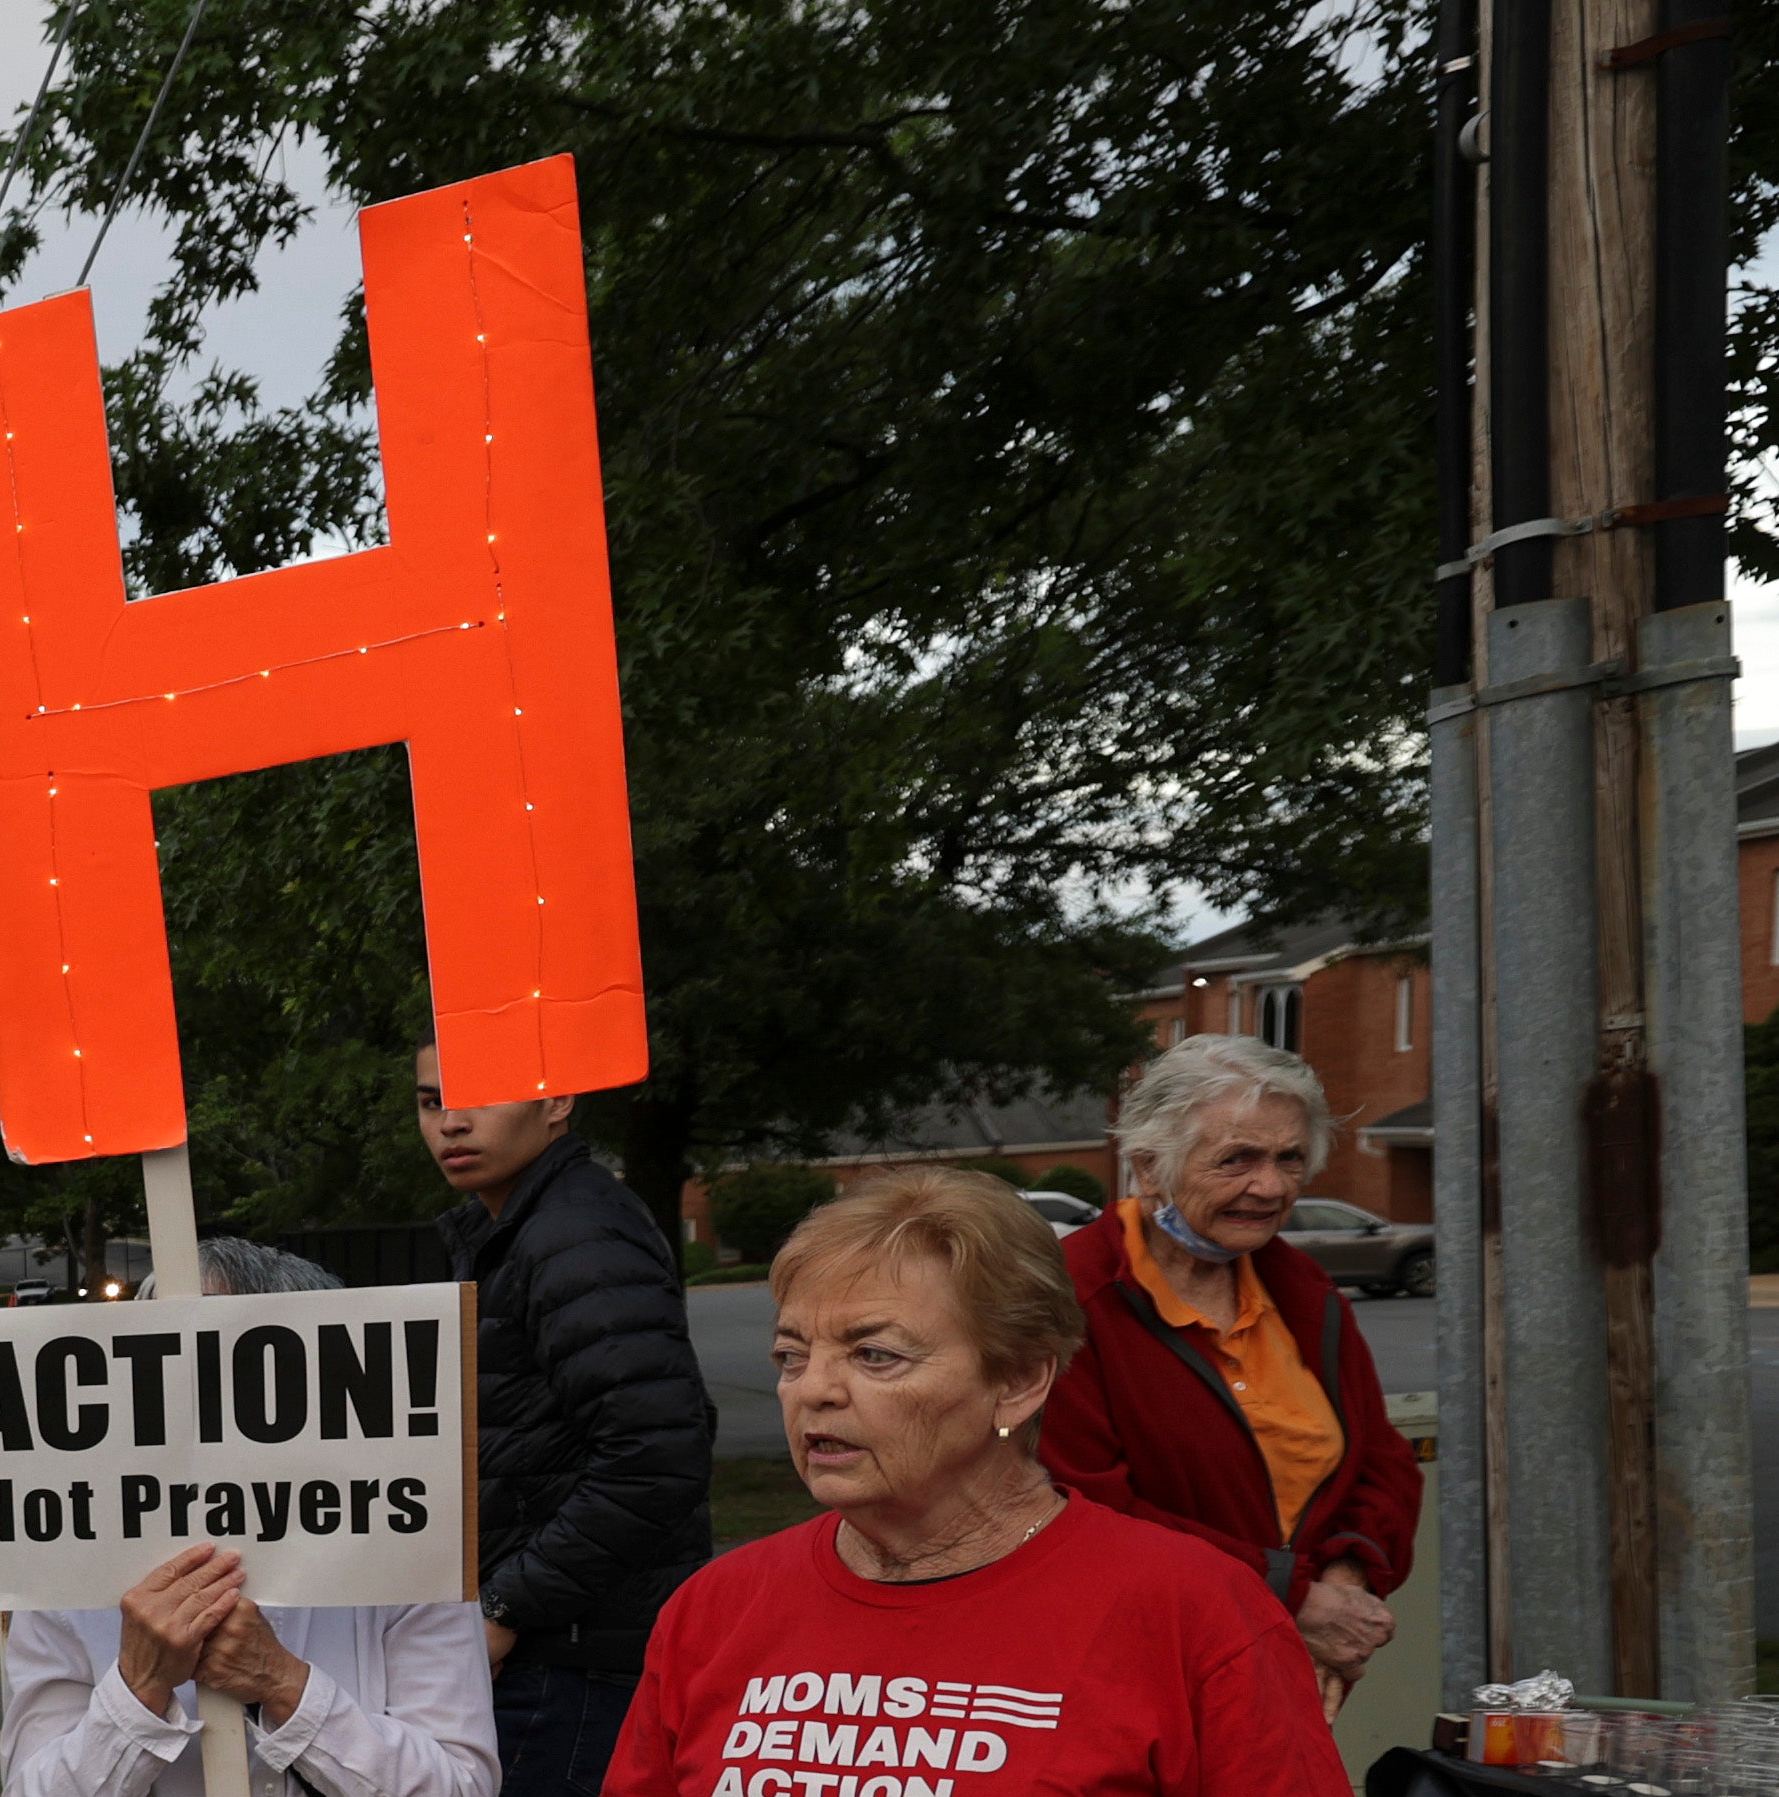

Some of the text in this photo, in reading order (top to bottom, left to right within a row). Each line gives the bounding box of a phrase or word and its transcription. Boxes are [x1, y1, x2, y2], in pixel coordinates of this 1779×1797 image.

[121, 1474, 429, 1543] Prayers
[738, 1671, 929, 1719] MOMS
[721, 1720, 1008, 1773] DEMAND
